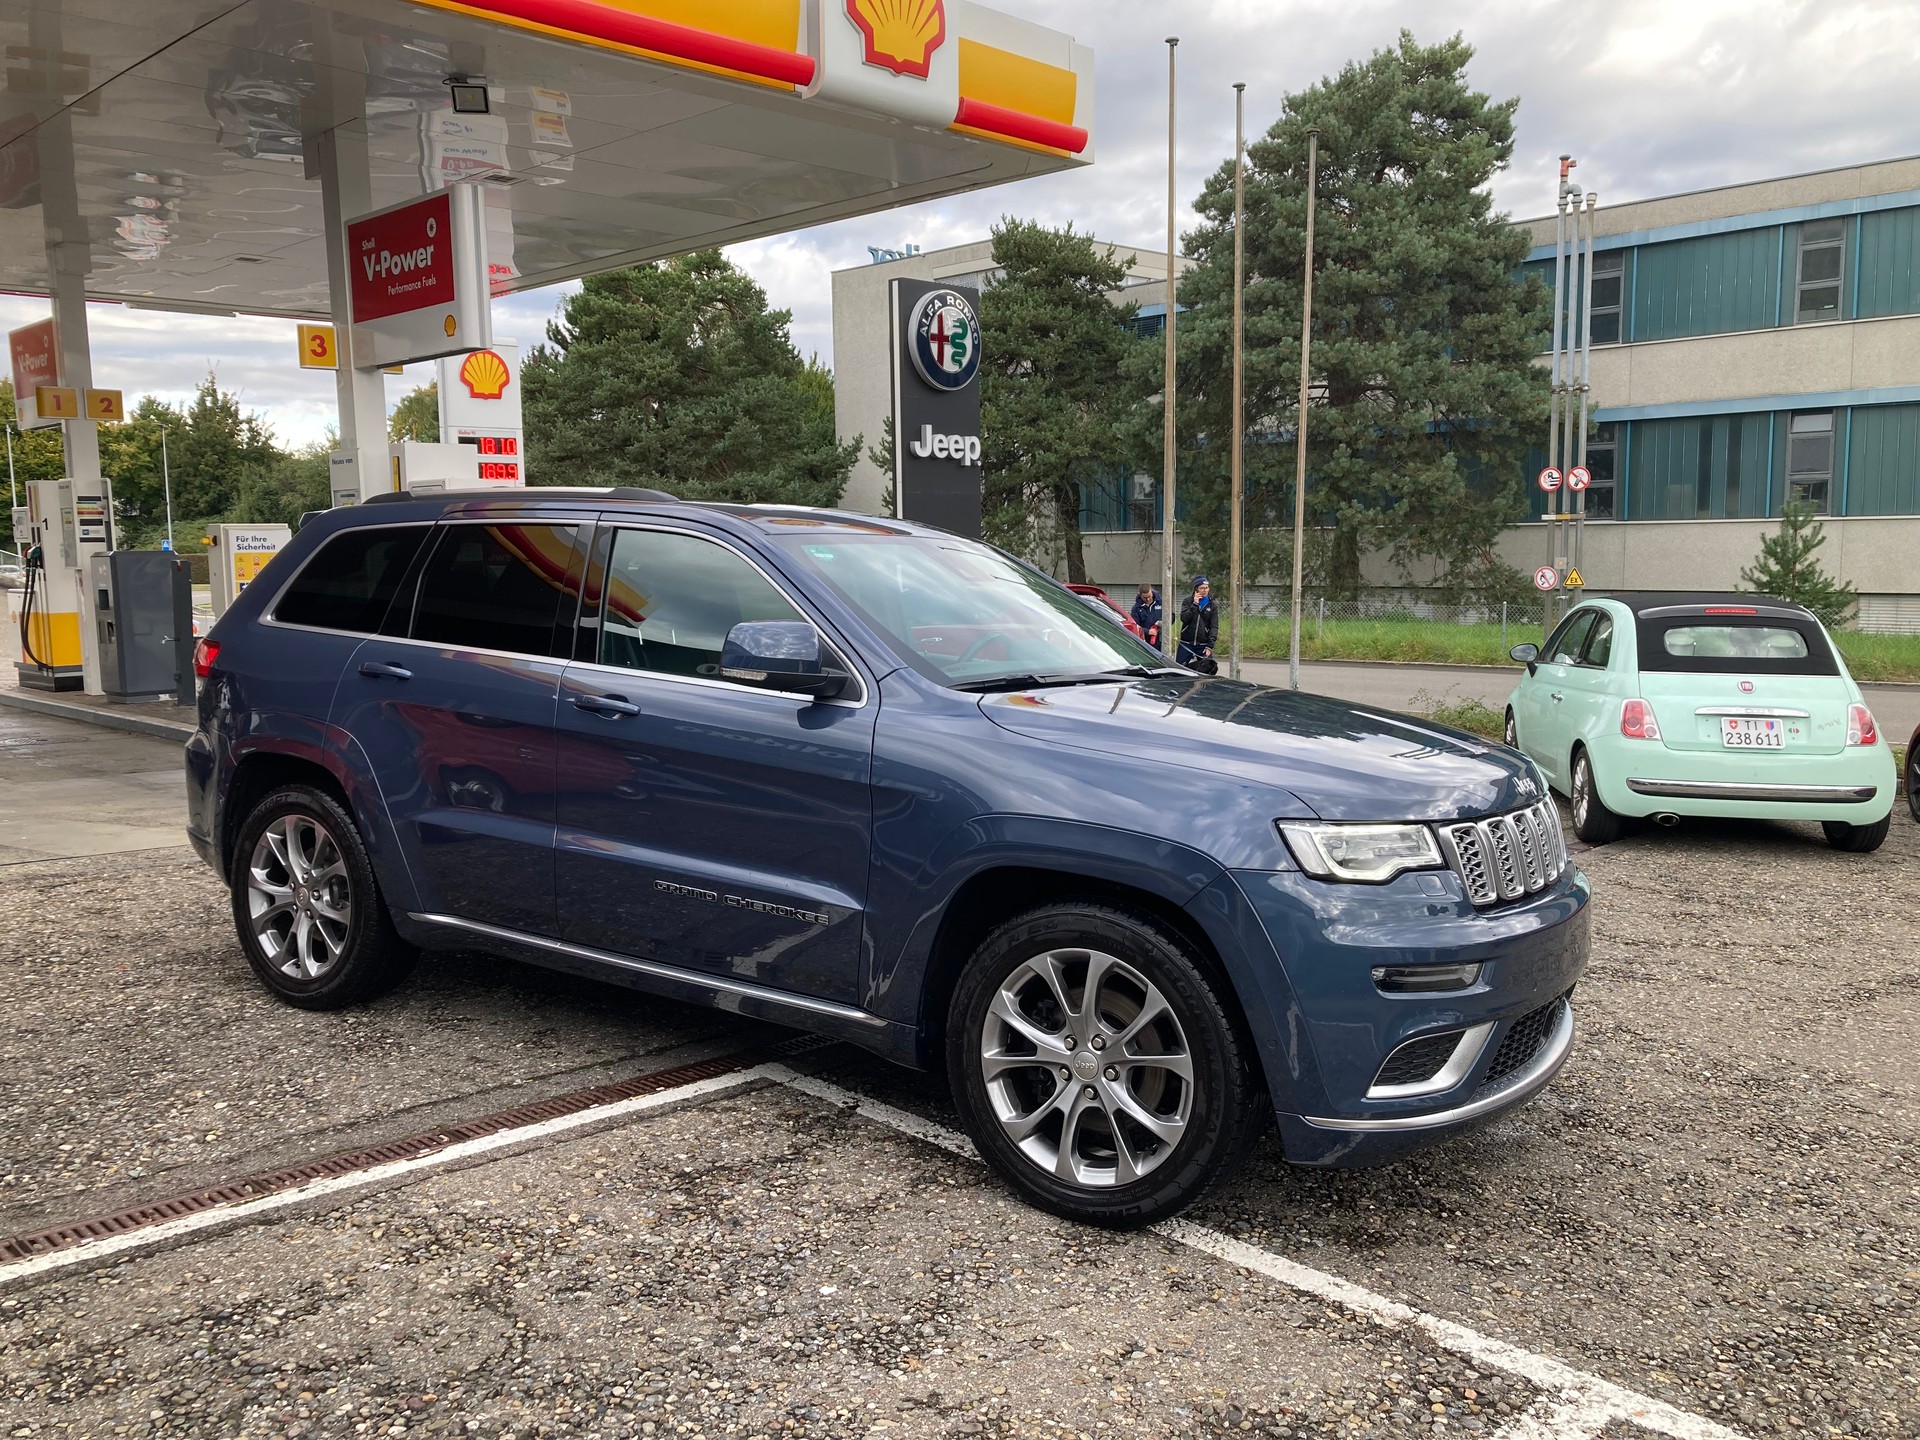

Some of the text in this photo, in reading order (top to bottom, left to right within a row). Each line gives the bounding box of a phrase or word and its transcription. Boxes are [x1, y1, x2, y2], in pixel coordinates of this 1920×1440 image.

[362, 237, 375, 250] Shell
[363, 244, 434, 282] V-Power
[387, 273, 437, 296] Performance Fuels
[920, 295, 979, 345] ALFA ROMEO
[310, 334, 328, 358] 3
[17, 353, 48, 373] V-Power
[53, 394, 62, 411] 1
[99, 397, 114, 413] 2
[910, 423, 981, 467] Jeep
[42, 517, 48, 531] 1
[235, 535, 267, 543] Für Ihre
[236, 543, 276, 551] Sicherheit
[1744, 720, 1758, 731] TI
[1725, 732, 1782, 746] 238 611
[1512, 776, 1538, 797] Jeep
[653, 879, 830, 927] GRAND CHEROKEE
[1075, 1060, 1096, 1070] Jeep
